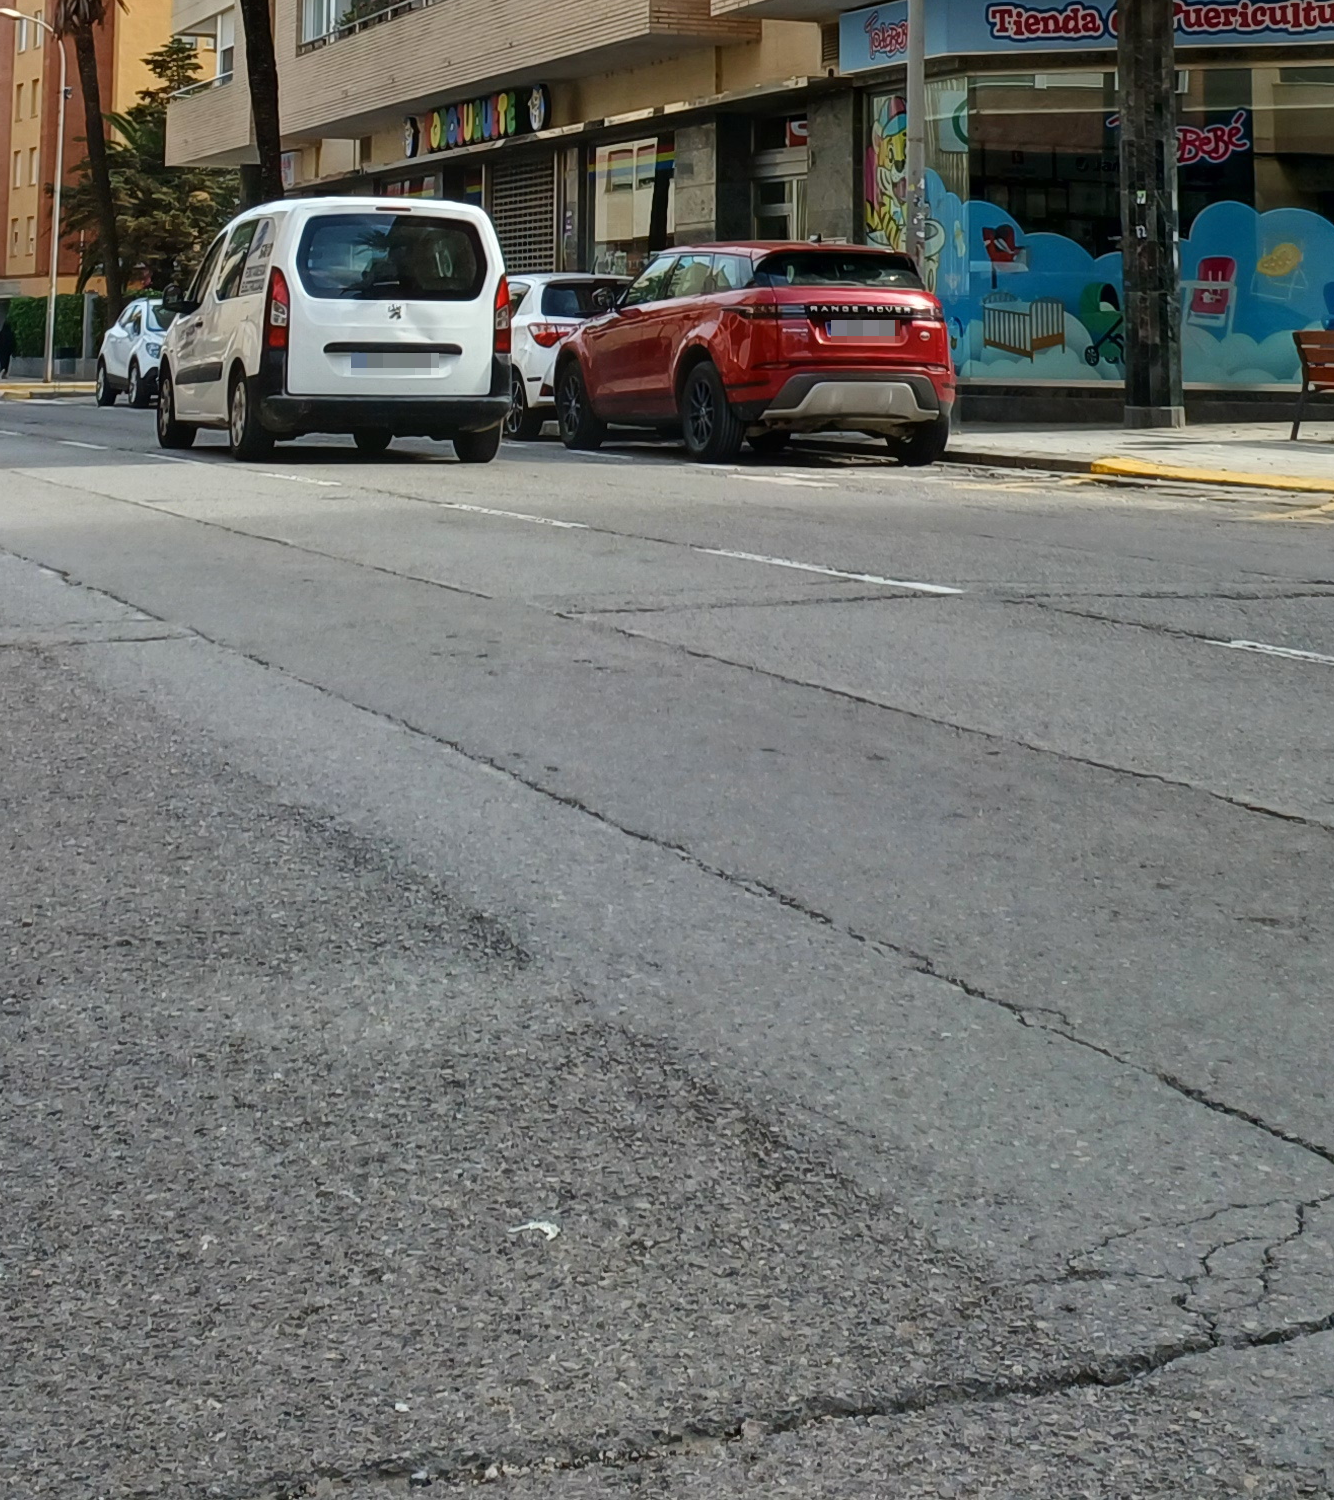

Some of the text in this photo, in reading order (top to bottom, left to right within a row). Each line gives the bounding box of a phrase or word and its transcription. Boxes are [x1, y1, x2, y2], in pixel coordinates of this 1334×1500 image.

[990, 5, 1101, 37] Tienda
[810, 305, 911, 314] RANGE ROVER
